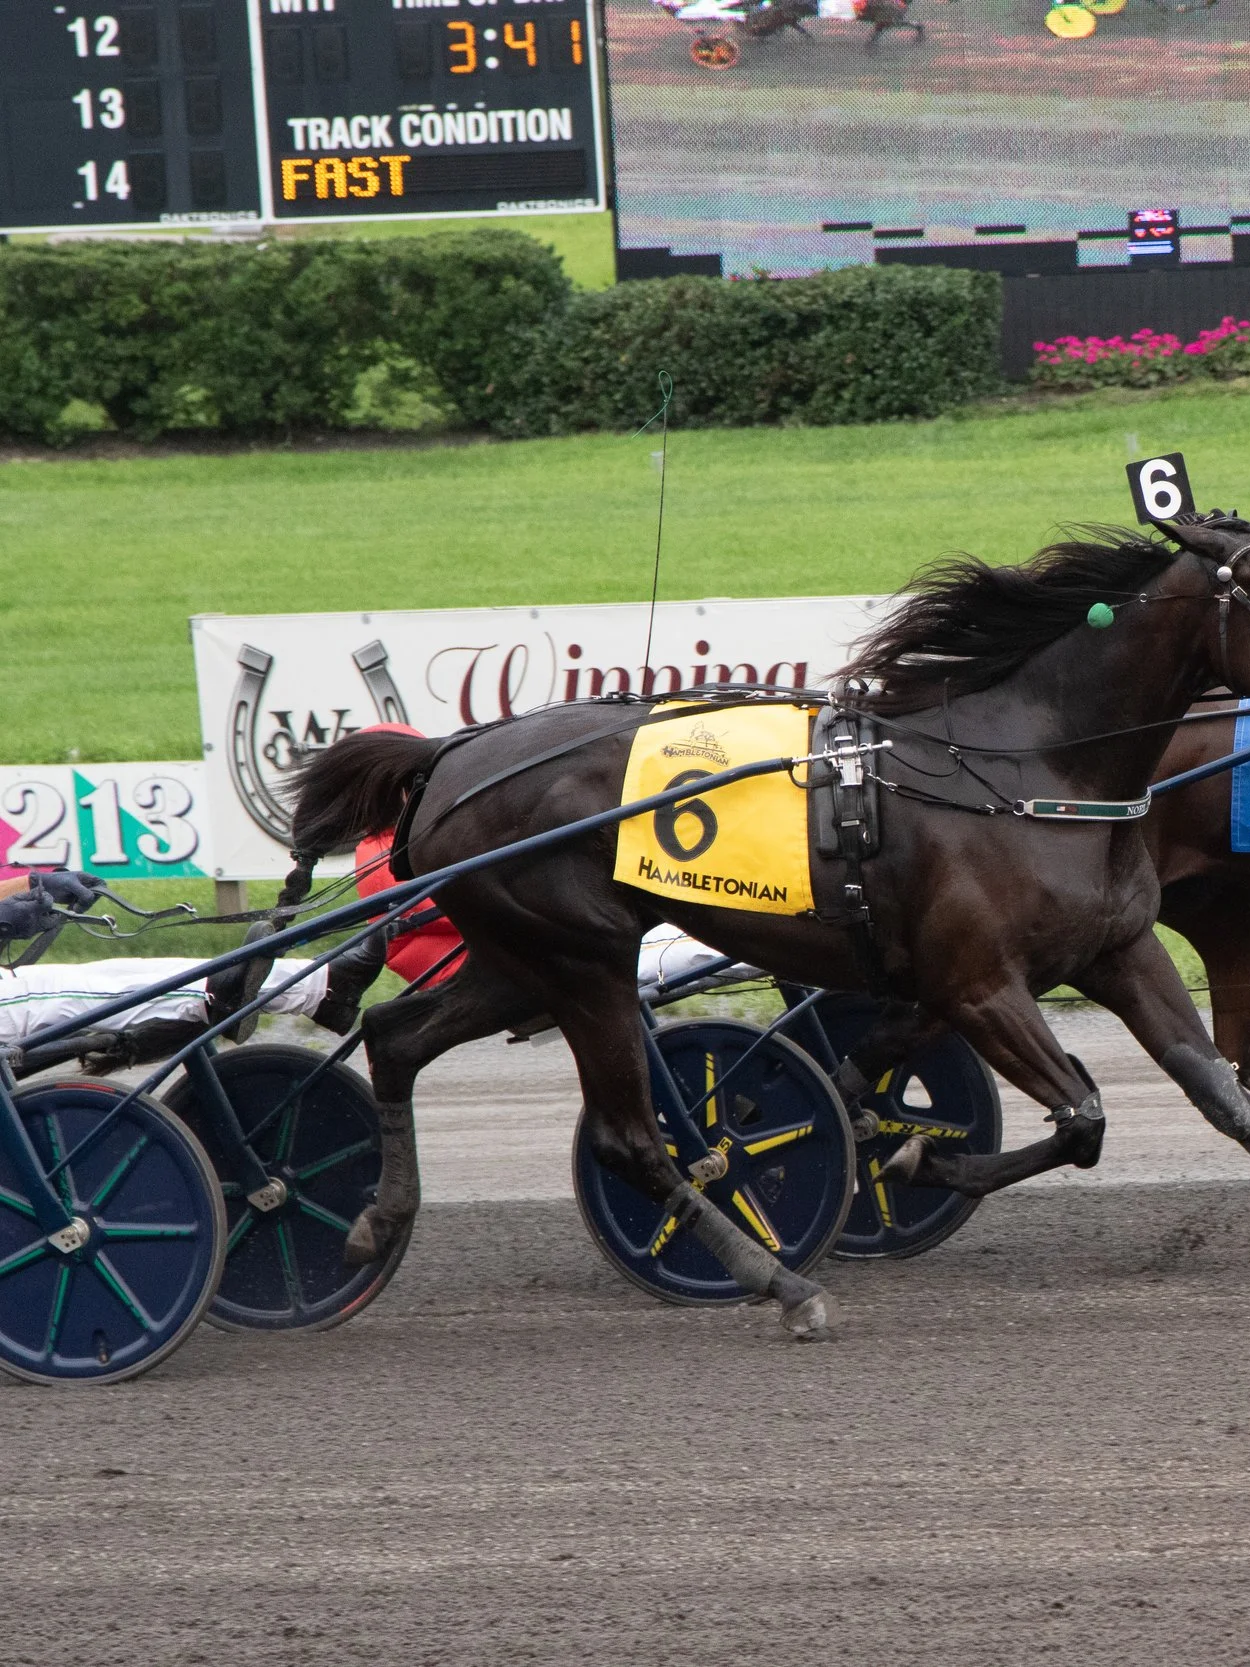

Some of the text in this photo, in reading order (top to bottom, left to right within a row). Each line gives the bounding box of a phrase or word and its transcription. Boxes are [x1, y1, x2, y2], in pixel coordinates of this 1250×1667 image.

[66, 16, 120, 57] 12
[72, 88, 125, 129] 13
[287, 108, 572, 150] TRACK CONDITION
[77, 160, 131, 201] 14
[281, 155, 411, 200] FAST
[1139, 458, 1182, 519] 6
[653, 768, 719, 863] 6
[637, 855, 788, 903] HAMBLETONIAN
